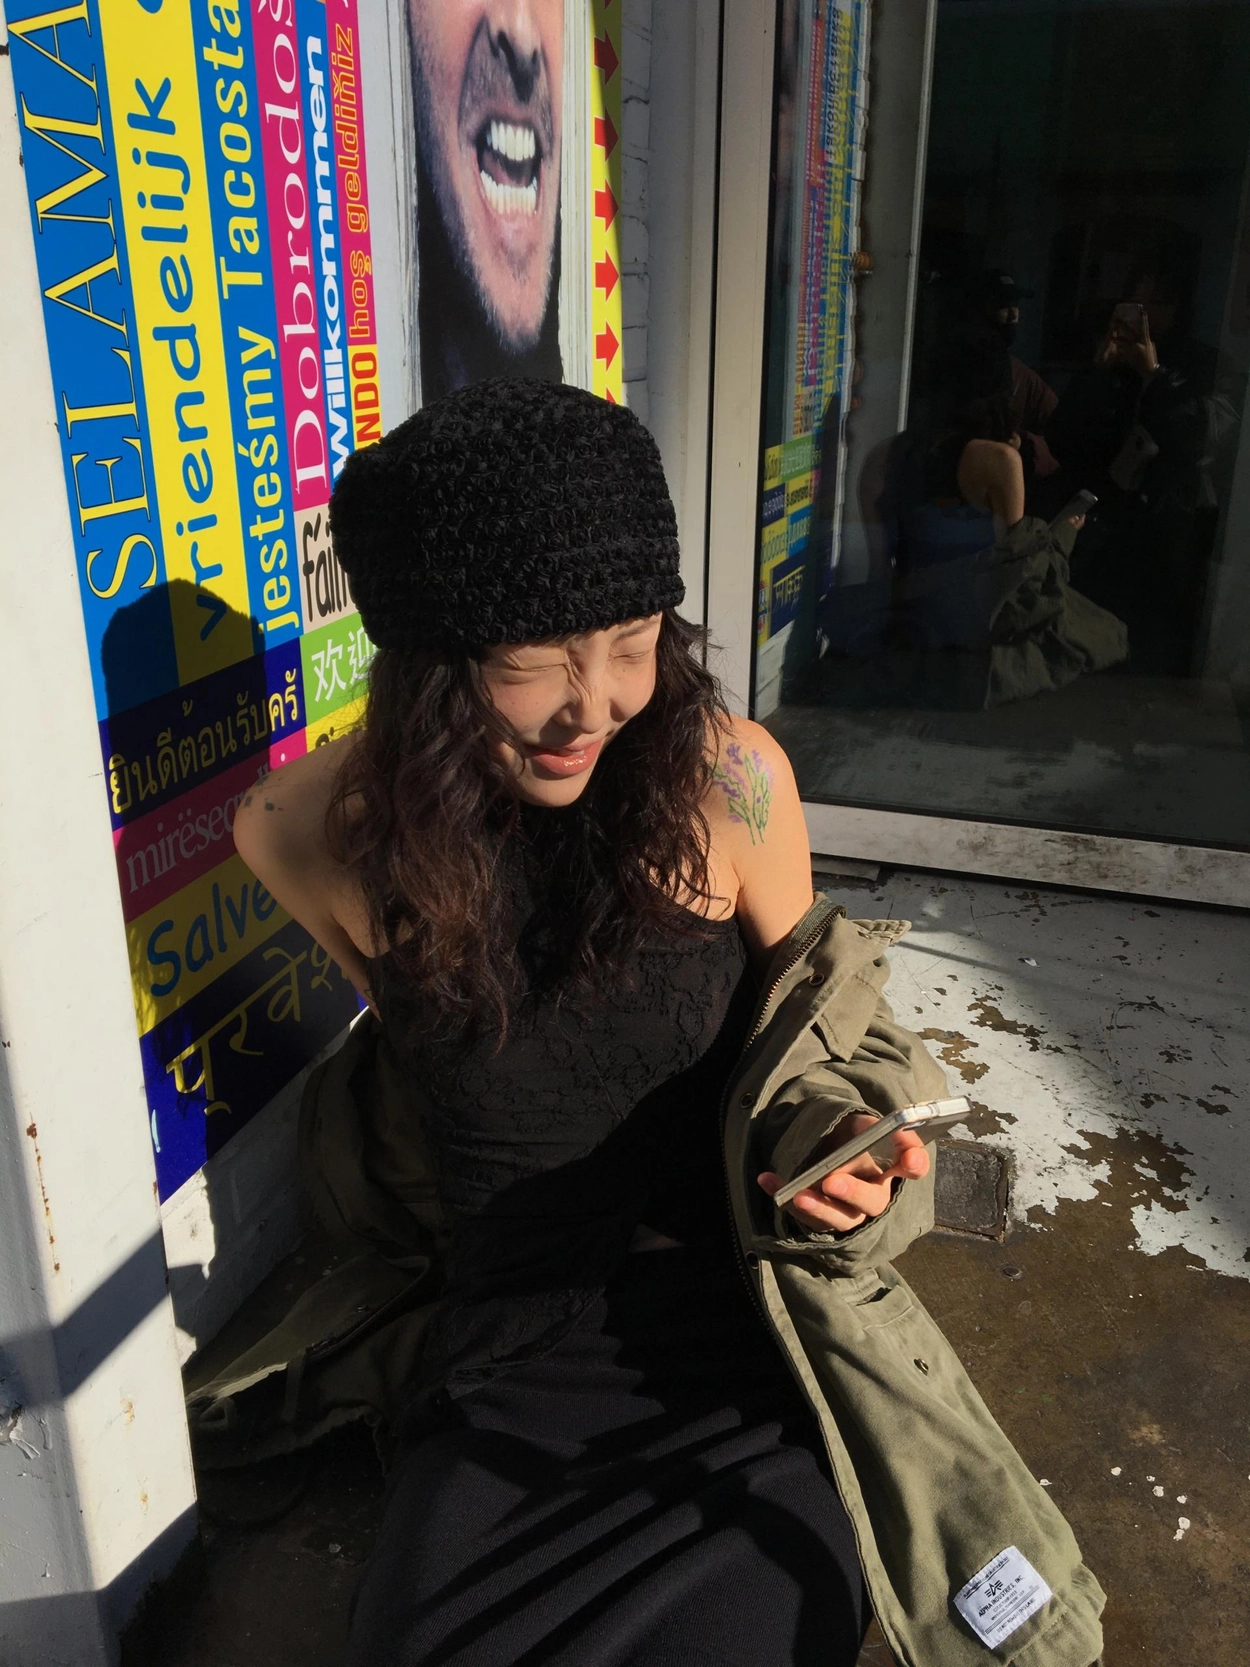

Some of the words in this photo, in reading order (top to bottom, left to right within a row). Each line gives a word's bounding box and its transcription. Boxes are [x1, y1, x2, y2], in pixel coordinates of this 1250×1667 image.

[127, 77, 228, 642] vriendelijk
[306, 35, 350, 480] willkommen
[237, 325, 300, 635] jesteśmy
[147, 879, 280, 998] Salve
[978, 1603, 993, 1617] ALPHA
